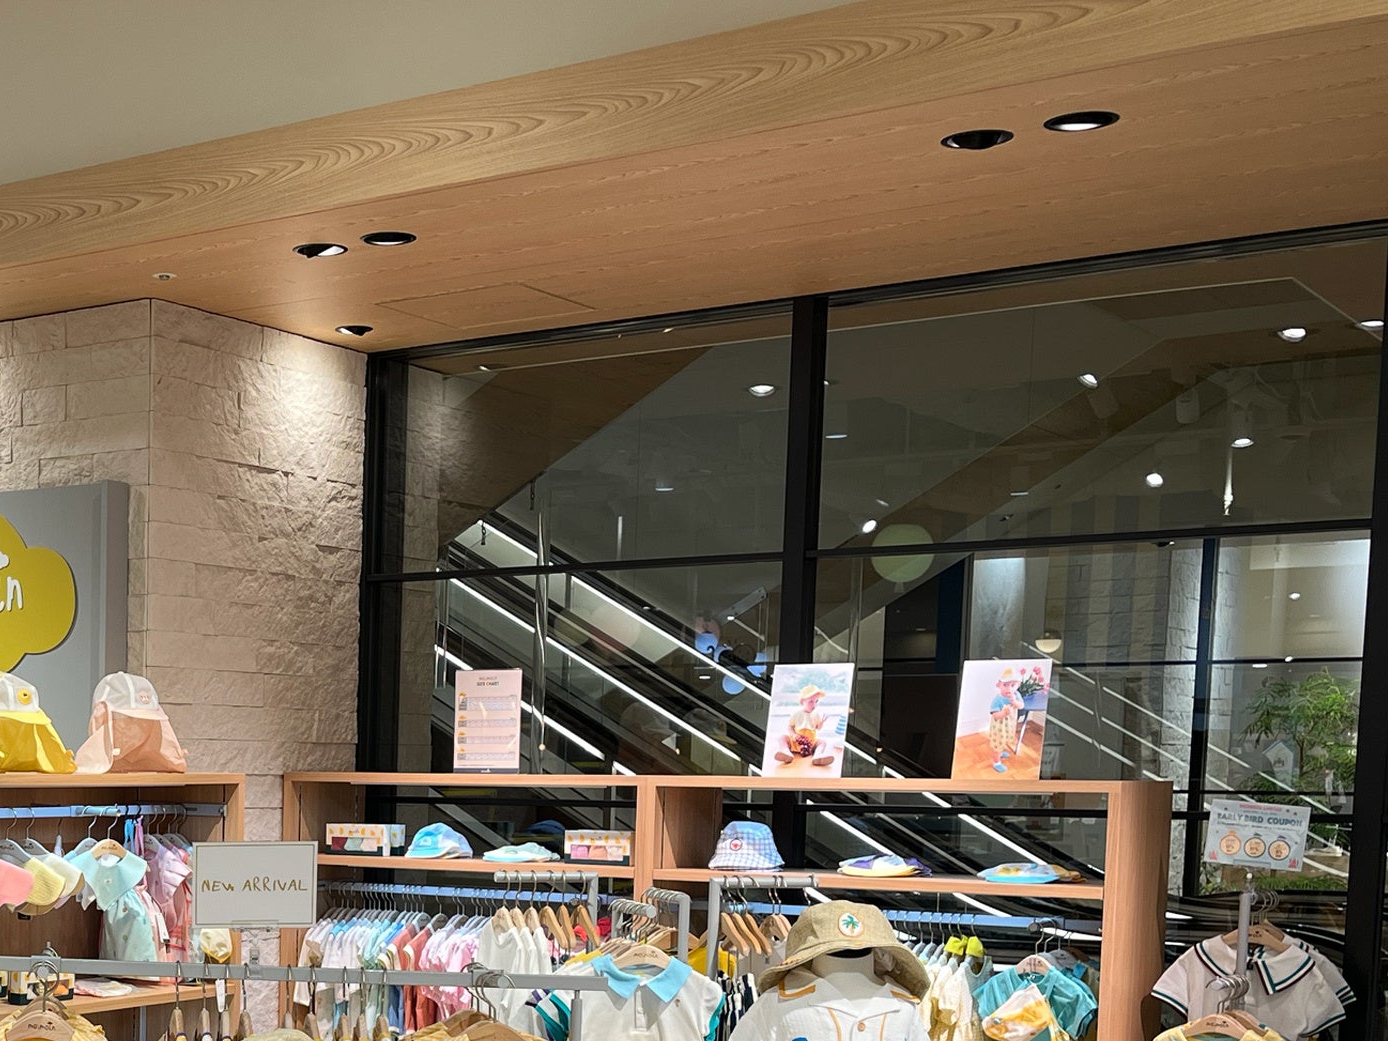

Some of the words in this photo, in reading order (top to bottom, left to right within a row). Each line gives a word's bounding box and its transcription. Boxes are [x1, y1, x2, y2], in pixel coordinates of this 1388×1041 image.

[1244, 815, 1264, 823] BIRD
[1267, 817, 1303, 826] COUPON
[202, 879, 234, 892] NEW
[242, 876, 308, 892] ARRIVAL
